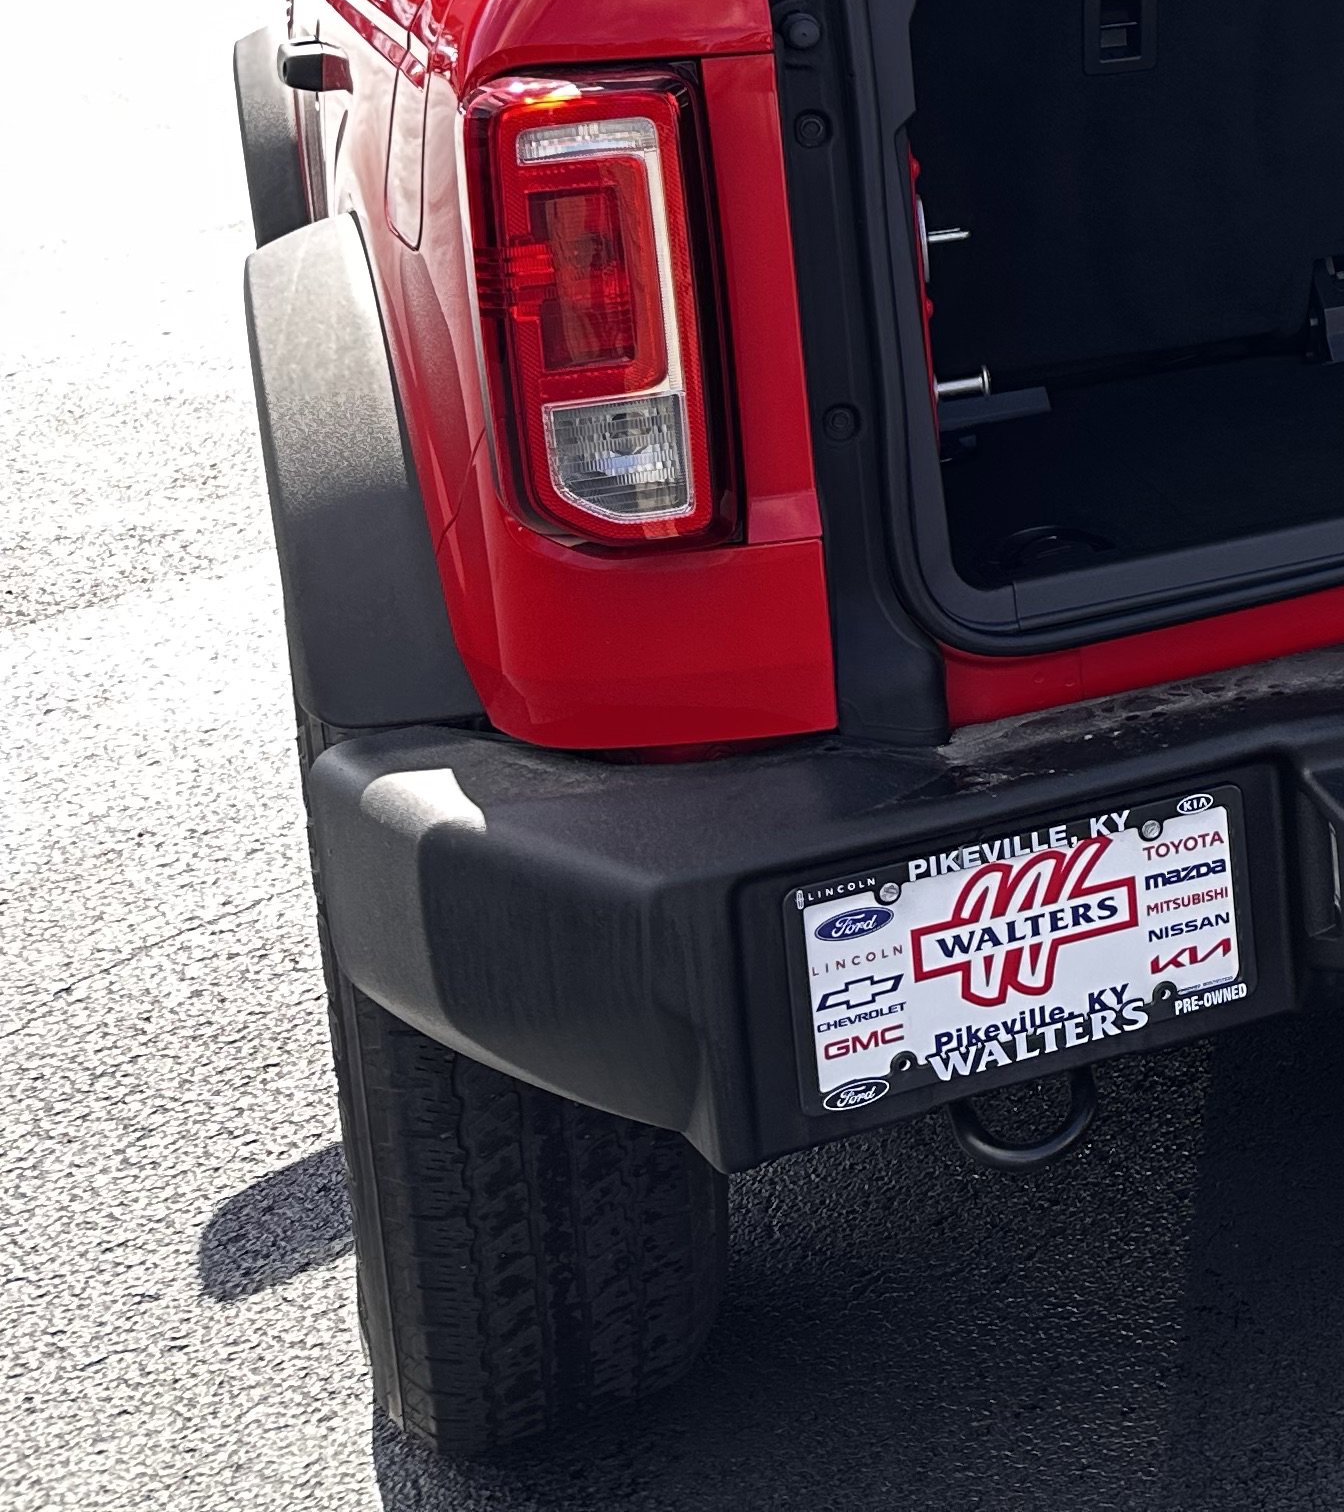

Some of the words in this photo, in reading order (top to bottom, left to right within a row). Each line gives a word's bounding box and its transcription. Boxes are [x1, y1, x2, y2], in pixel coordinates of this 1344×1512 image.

[1182, 797, 1208, 812] KIA
[908, 824, 1078, 882] PIKEVILLE,
[1089, 809, 1131, 838] KY
[1142, 830, 1225, 861] TOYOTA
[807, 877, 876, 901] LINCOLN
[1146, 886, 1229, 917] MITSUBISHI
[831, 913, 878, 938] Ford
[936, 896, 1119, 959] WALTERS
[1148, 911, 1230, 943] NISSAN
[812, 945, 903, 977] LINCOLN
[1150, 937, 1232, 975] KIA
[1088, 982, 1129, 1014] KY
[1174, 982, 1248, 1016] PRE-OWNED
[816, 1001, 907, 1034] CHEVROLET
[824, 1023, 905, 1061] GMC
[927, 999, 1149, 1082] WALTERS
[836, 1085, 877, 1108] Ford
